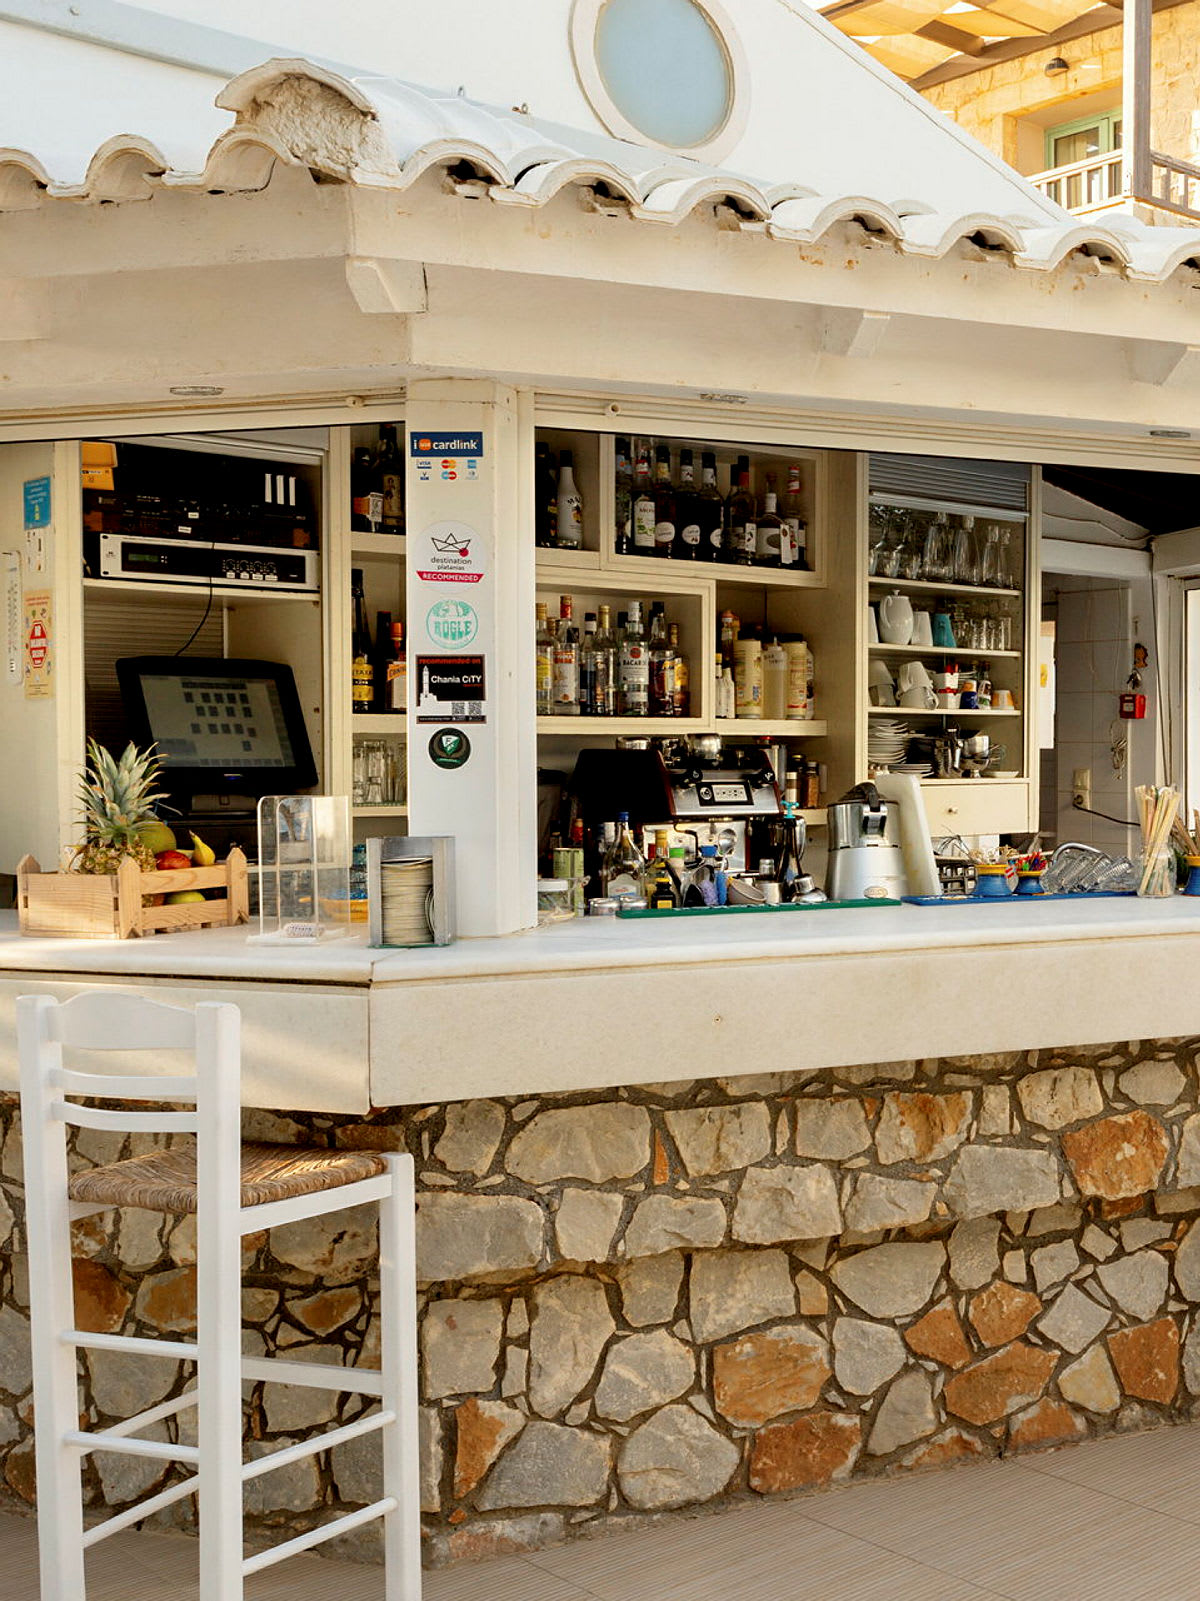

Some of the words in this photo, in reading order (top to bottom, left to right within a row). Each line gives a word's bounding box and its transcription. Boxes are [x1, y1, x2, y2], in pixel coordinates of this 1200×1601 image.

[432, 439, 478, 450] cardlink
[430, 556, 472, 565] destination
[422, 573, 479, 581] RECOMMENDED
[430, 674, 461, 684] Chania
